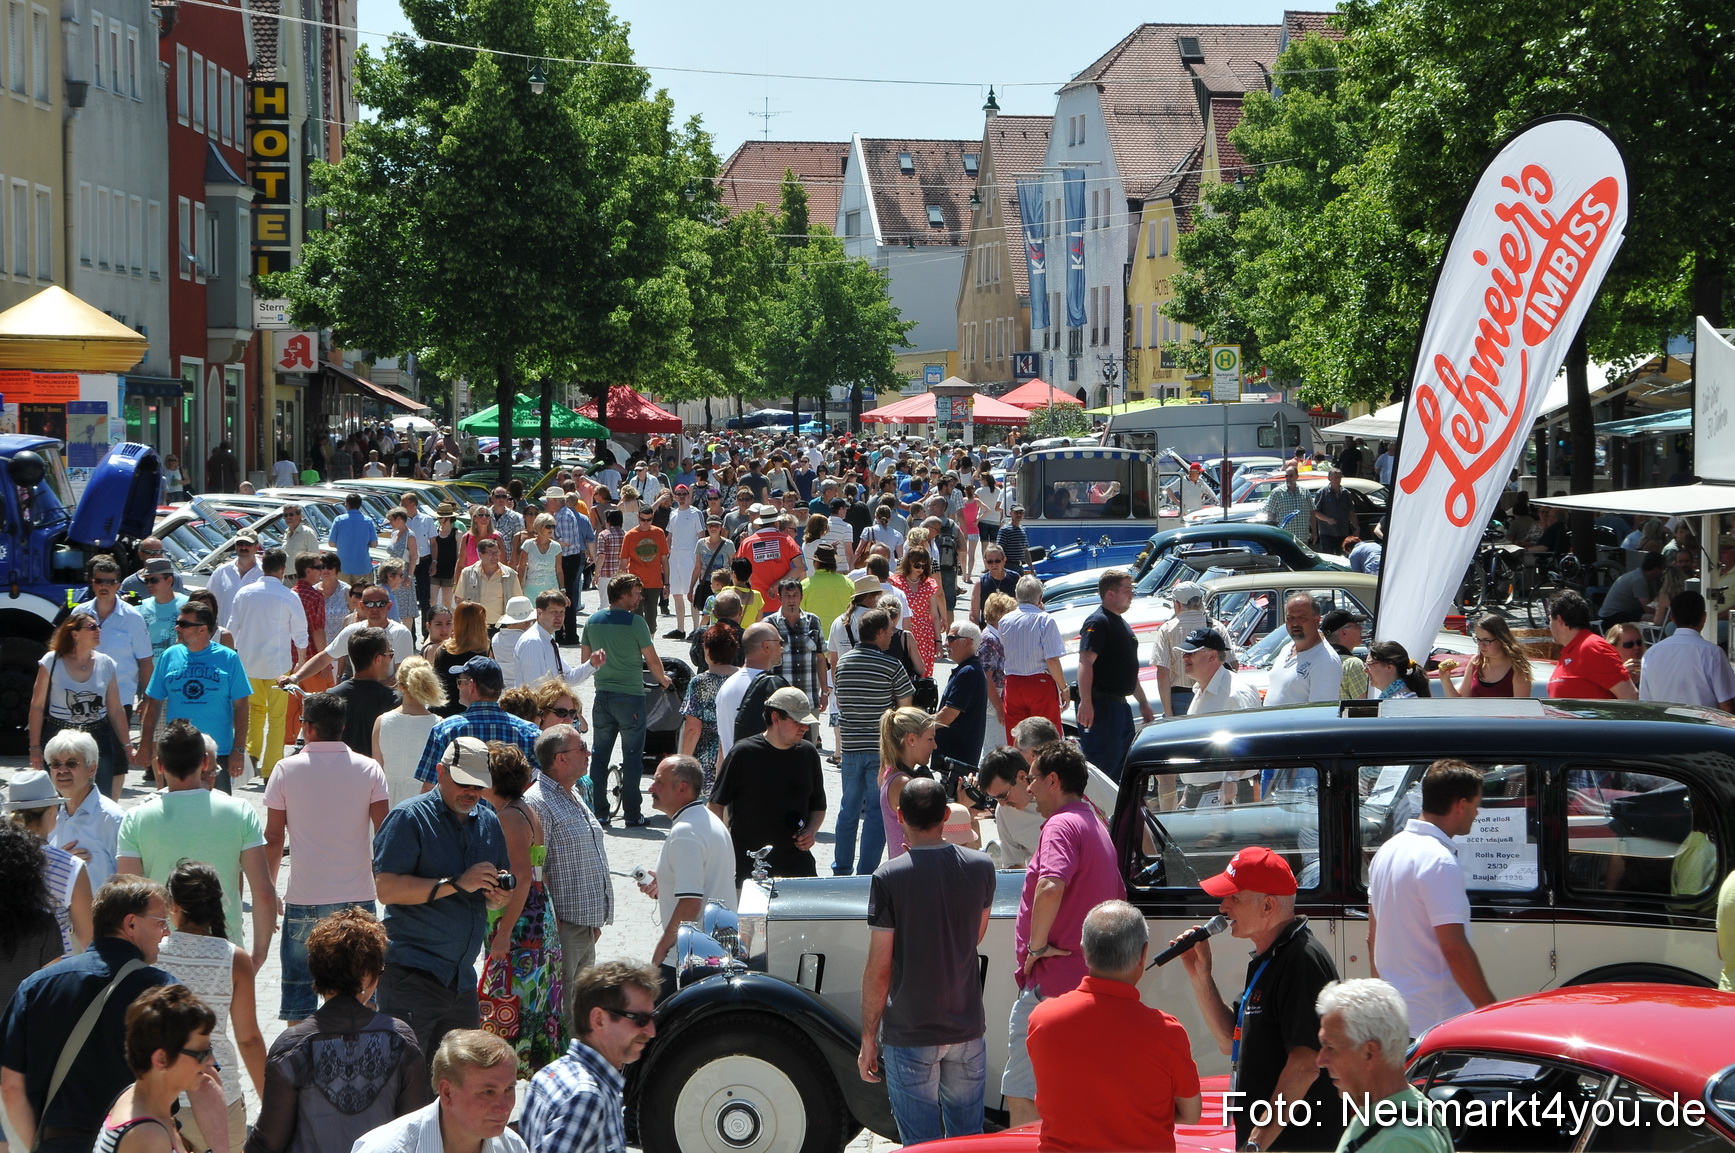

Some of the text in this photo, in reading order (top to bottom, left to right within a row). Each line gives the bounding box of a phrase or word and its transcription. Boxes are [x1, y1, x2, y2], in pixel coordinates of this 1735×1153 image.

[1525, 192, 1610, 333] IMBISS
[259, 303, 285, 312] Stern
[1400, 163, 1559, 527] Lehmeier's
[1220, 354, 1231, 366] H
[47, 405, 62, 413] Bones
[168, 666, 220, 684] JUNGLE
[1496, 852, 1520, 860] Royce
[1472, 873, 1523, 882] Baujahr 1936
